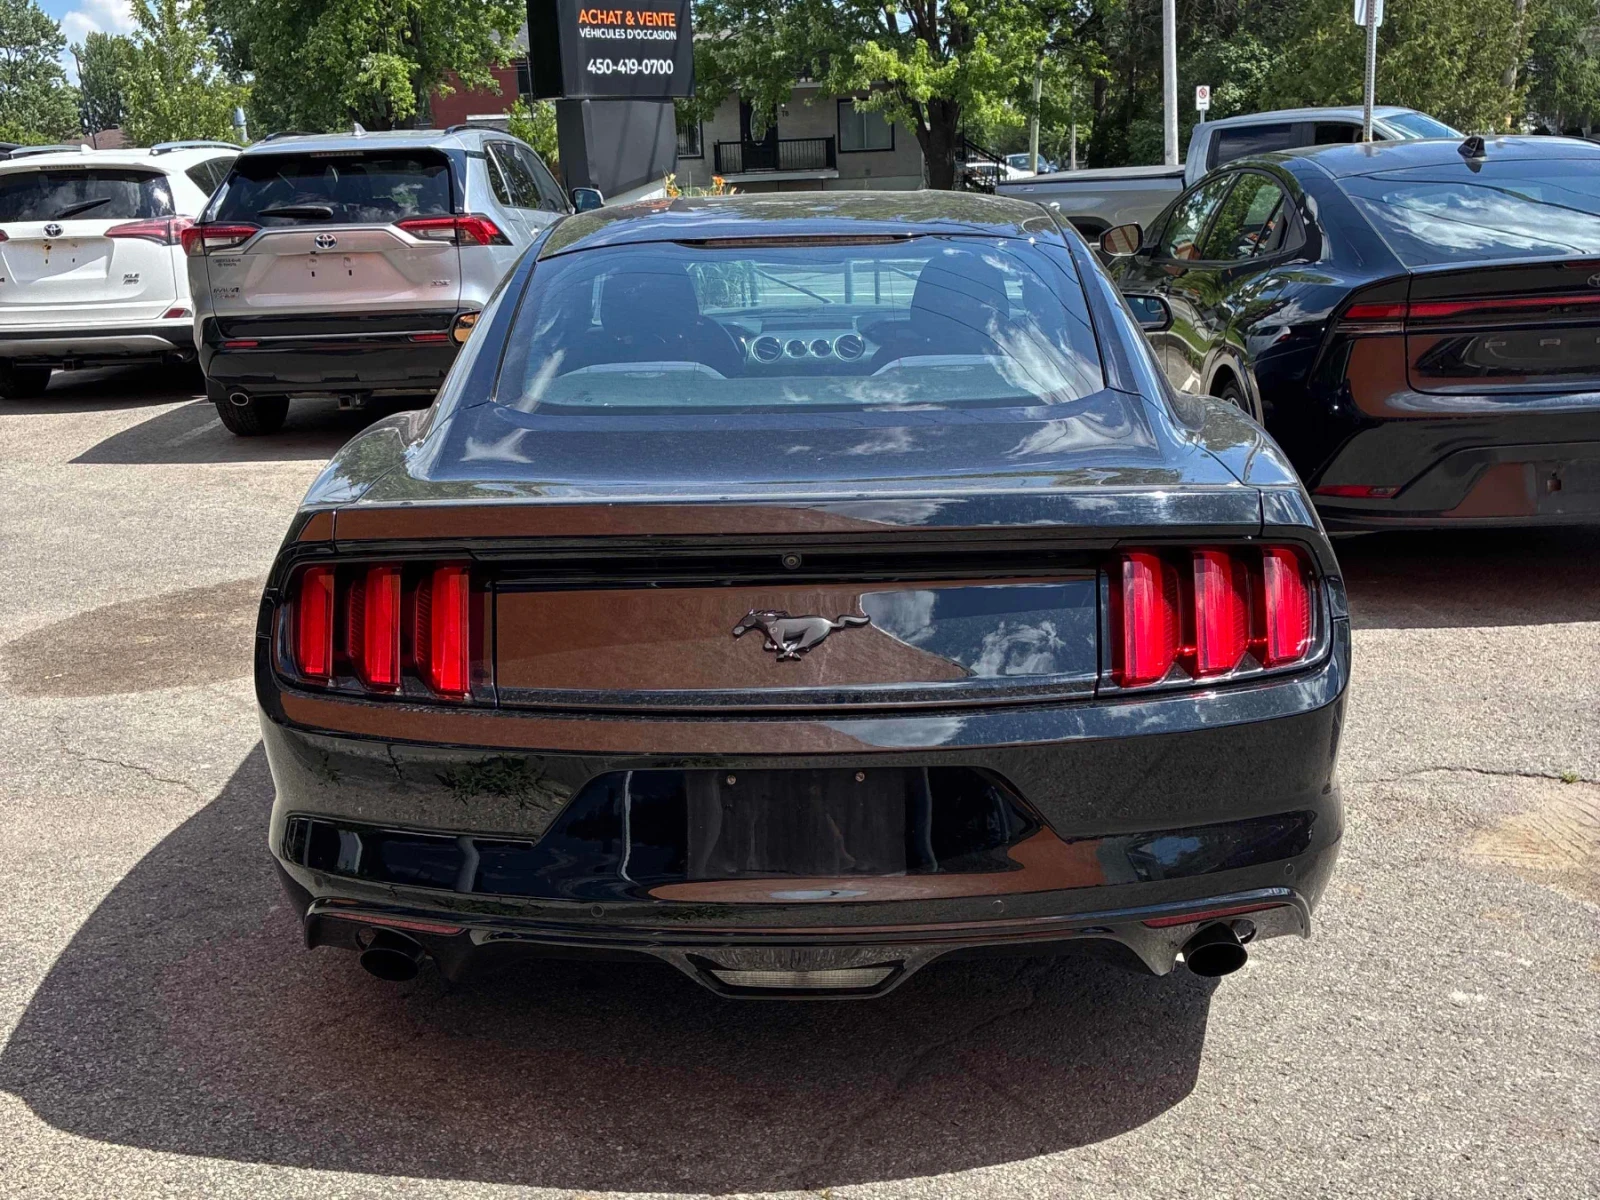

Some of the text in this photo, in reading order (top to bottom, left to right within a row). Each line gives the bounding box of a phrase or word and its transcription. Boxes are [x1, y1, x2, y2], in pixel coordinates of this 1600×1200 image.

[578, 9, 677, 27] ACHAT & VENTE
[579, 26, 677, 41] VÉHICULES D'OCCASION
[587, 58, 674, 75] 450-419-0700
